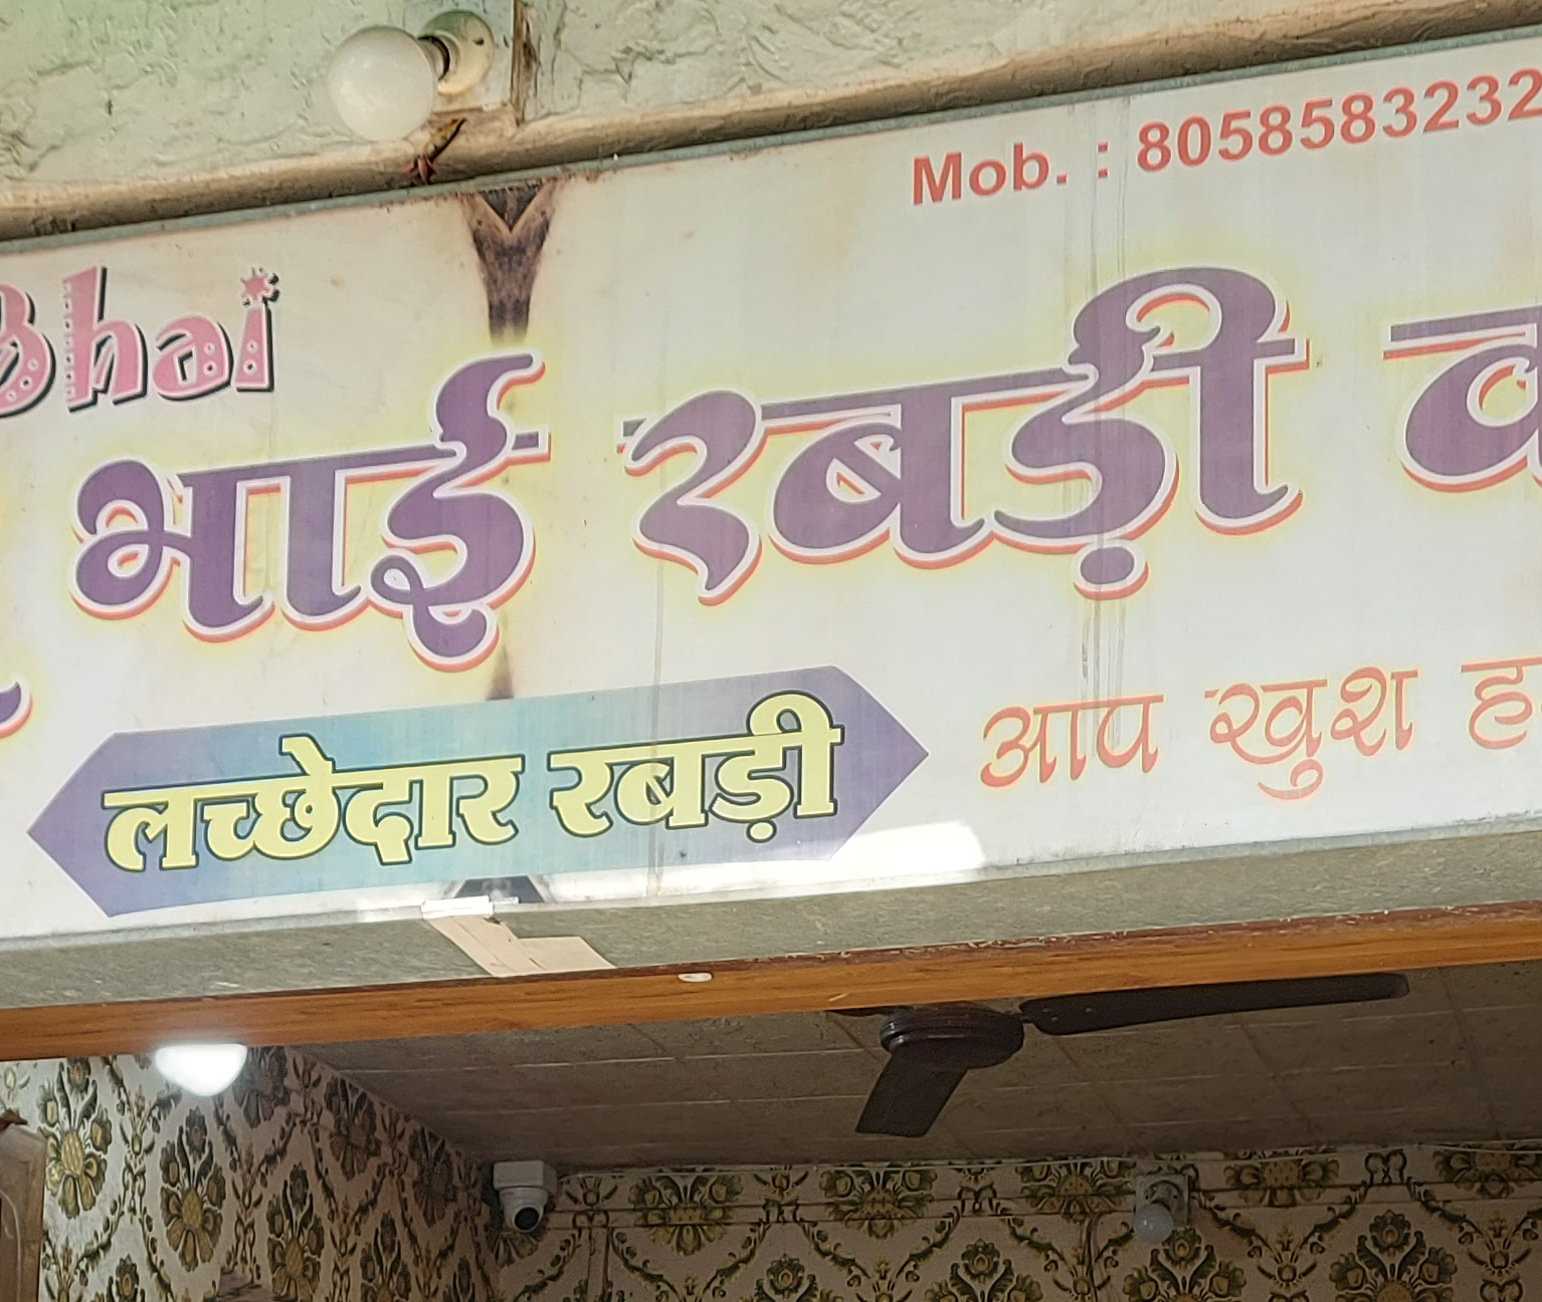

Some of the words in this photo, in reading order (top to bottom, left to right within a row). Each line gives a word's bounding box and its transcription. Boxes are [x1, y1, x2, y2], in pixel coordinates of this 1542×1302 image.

[909, 150, 1068, 206] Mob.
[73, 352, 551, 671] भाई
[621, 264, 1309, 608] रबड़ी
[102, 736, 525, 874] लच्छेदार
[547, 689, 844, 845] रबड़ी
[980, 691, 1166, 789] आप
[1205, 666, 1419, 800] खुश
